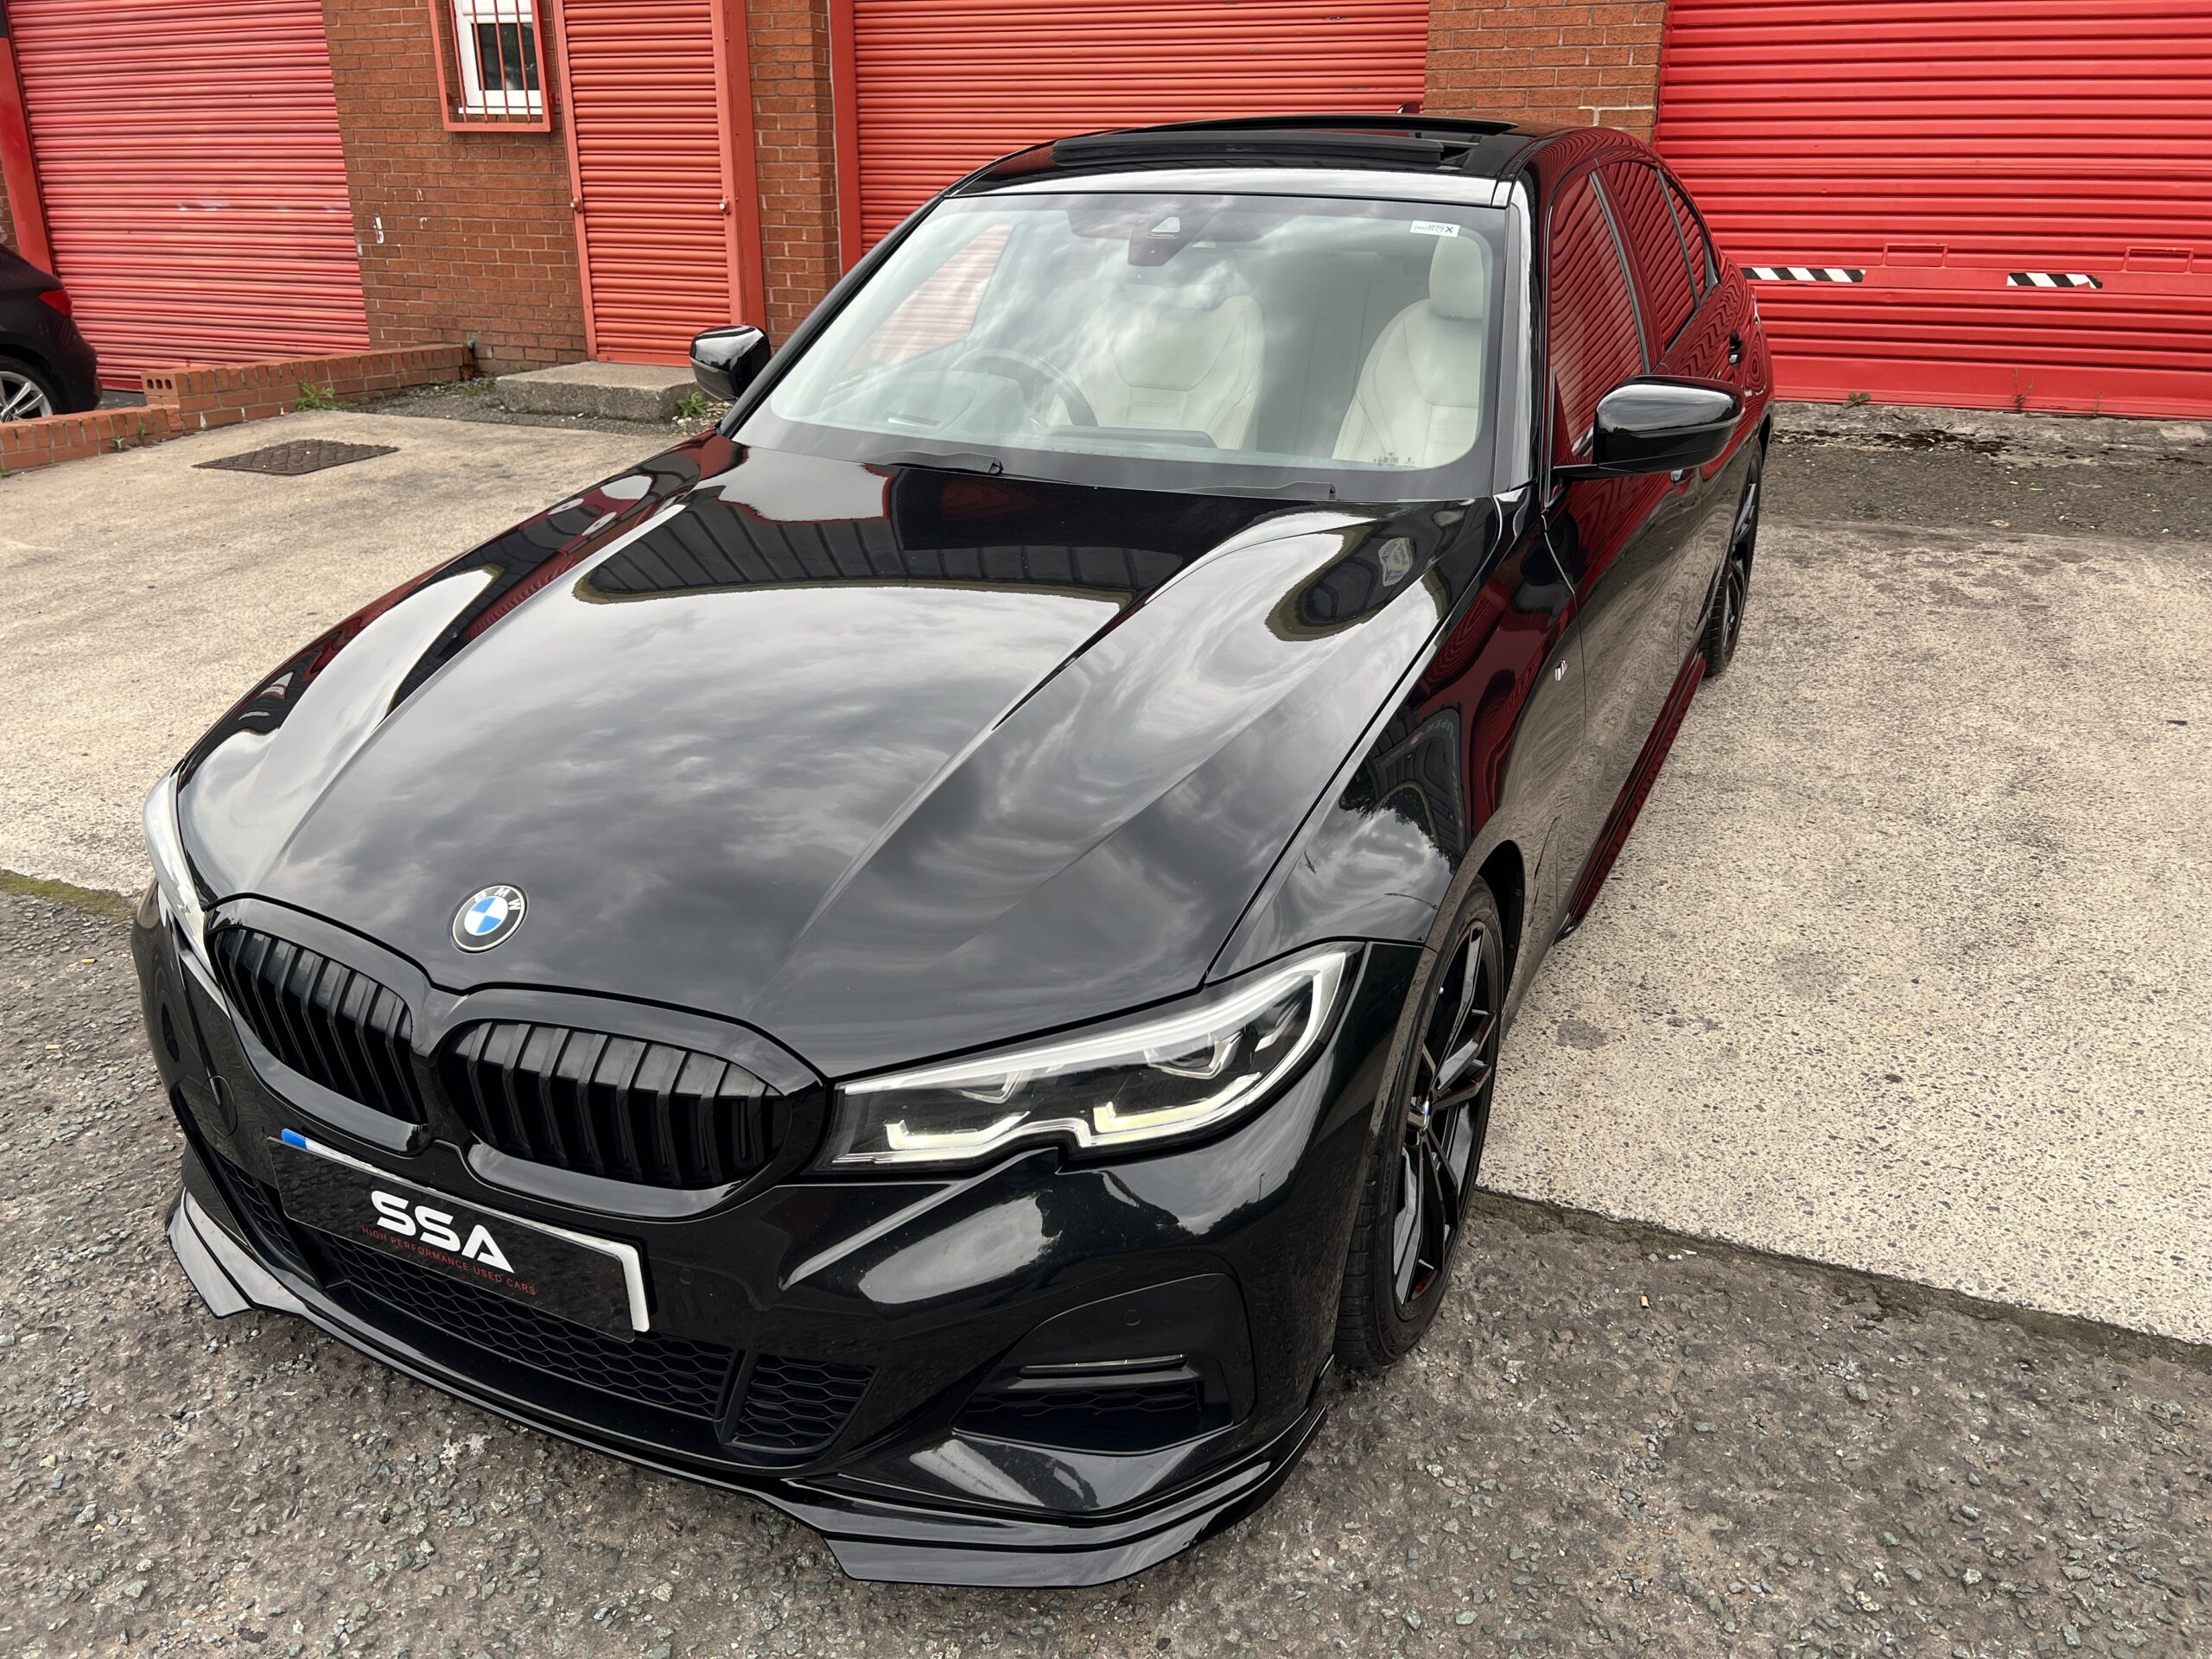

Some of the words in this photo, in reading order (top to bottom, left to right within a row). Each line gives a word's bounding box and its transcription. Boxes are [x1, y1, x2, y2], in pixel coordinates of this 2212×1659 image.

[474, 887, 522, 911] BMW
[362, 1226, 388, 1242] HIGH
[390, 1236, 469, 1271] PERFORMANCE
[474, 1265, 503, 1283] USED
[506, 1277, 537, 1295] CARS
[371, 1190, 515, 1274] SSA
